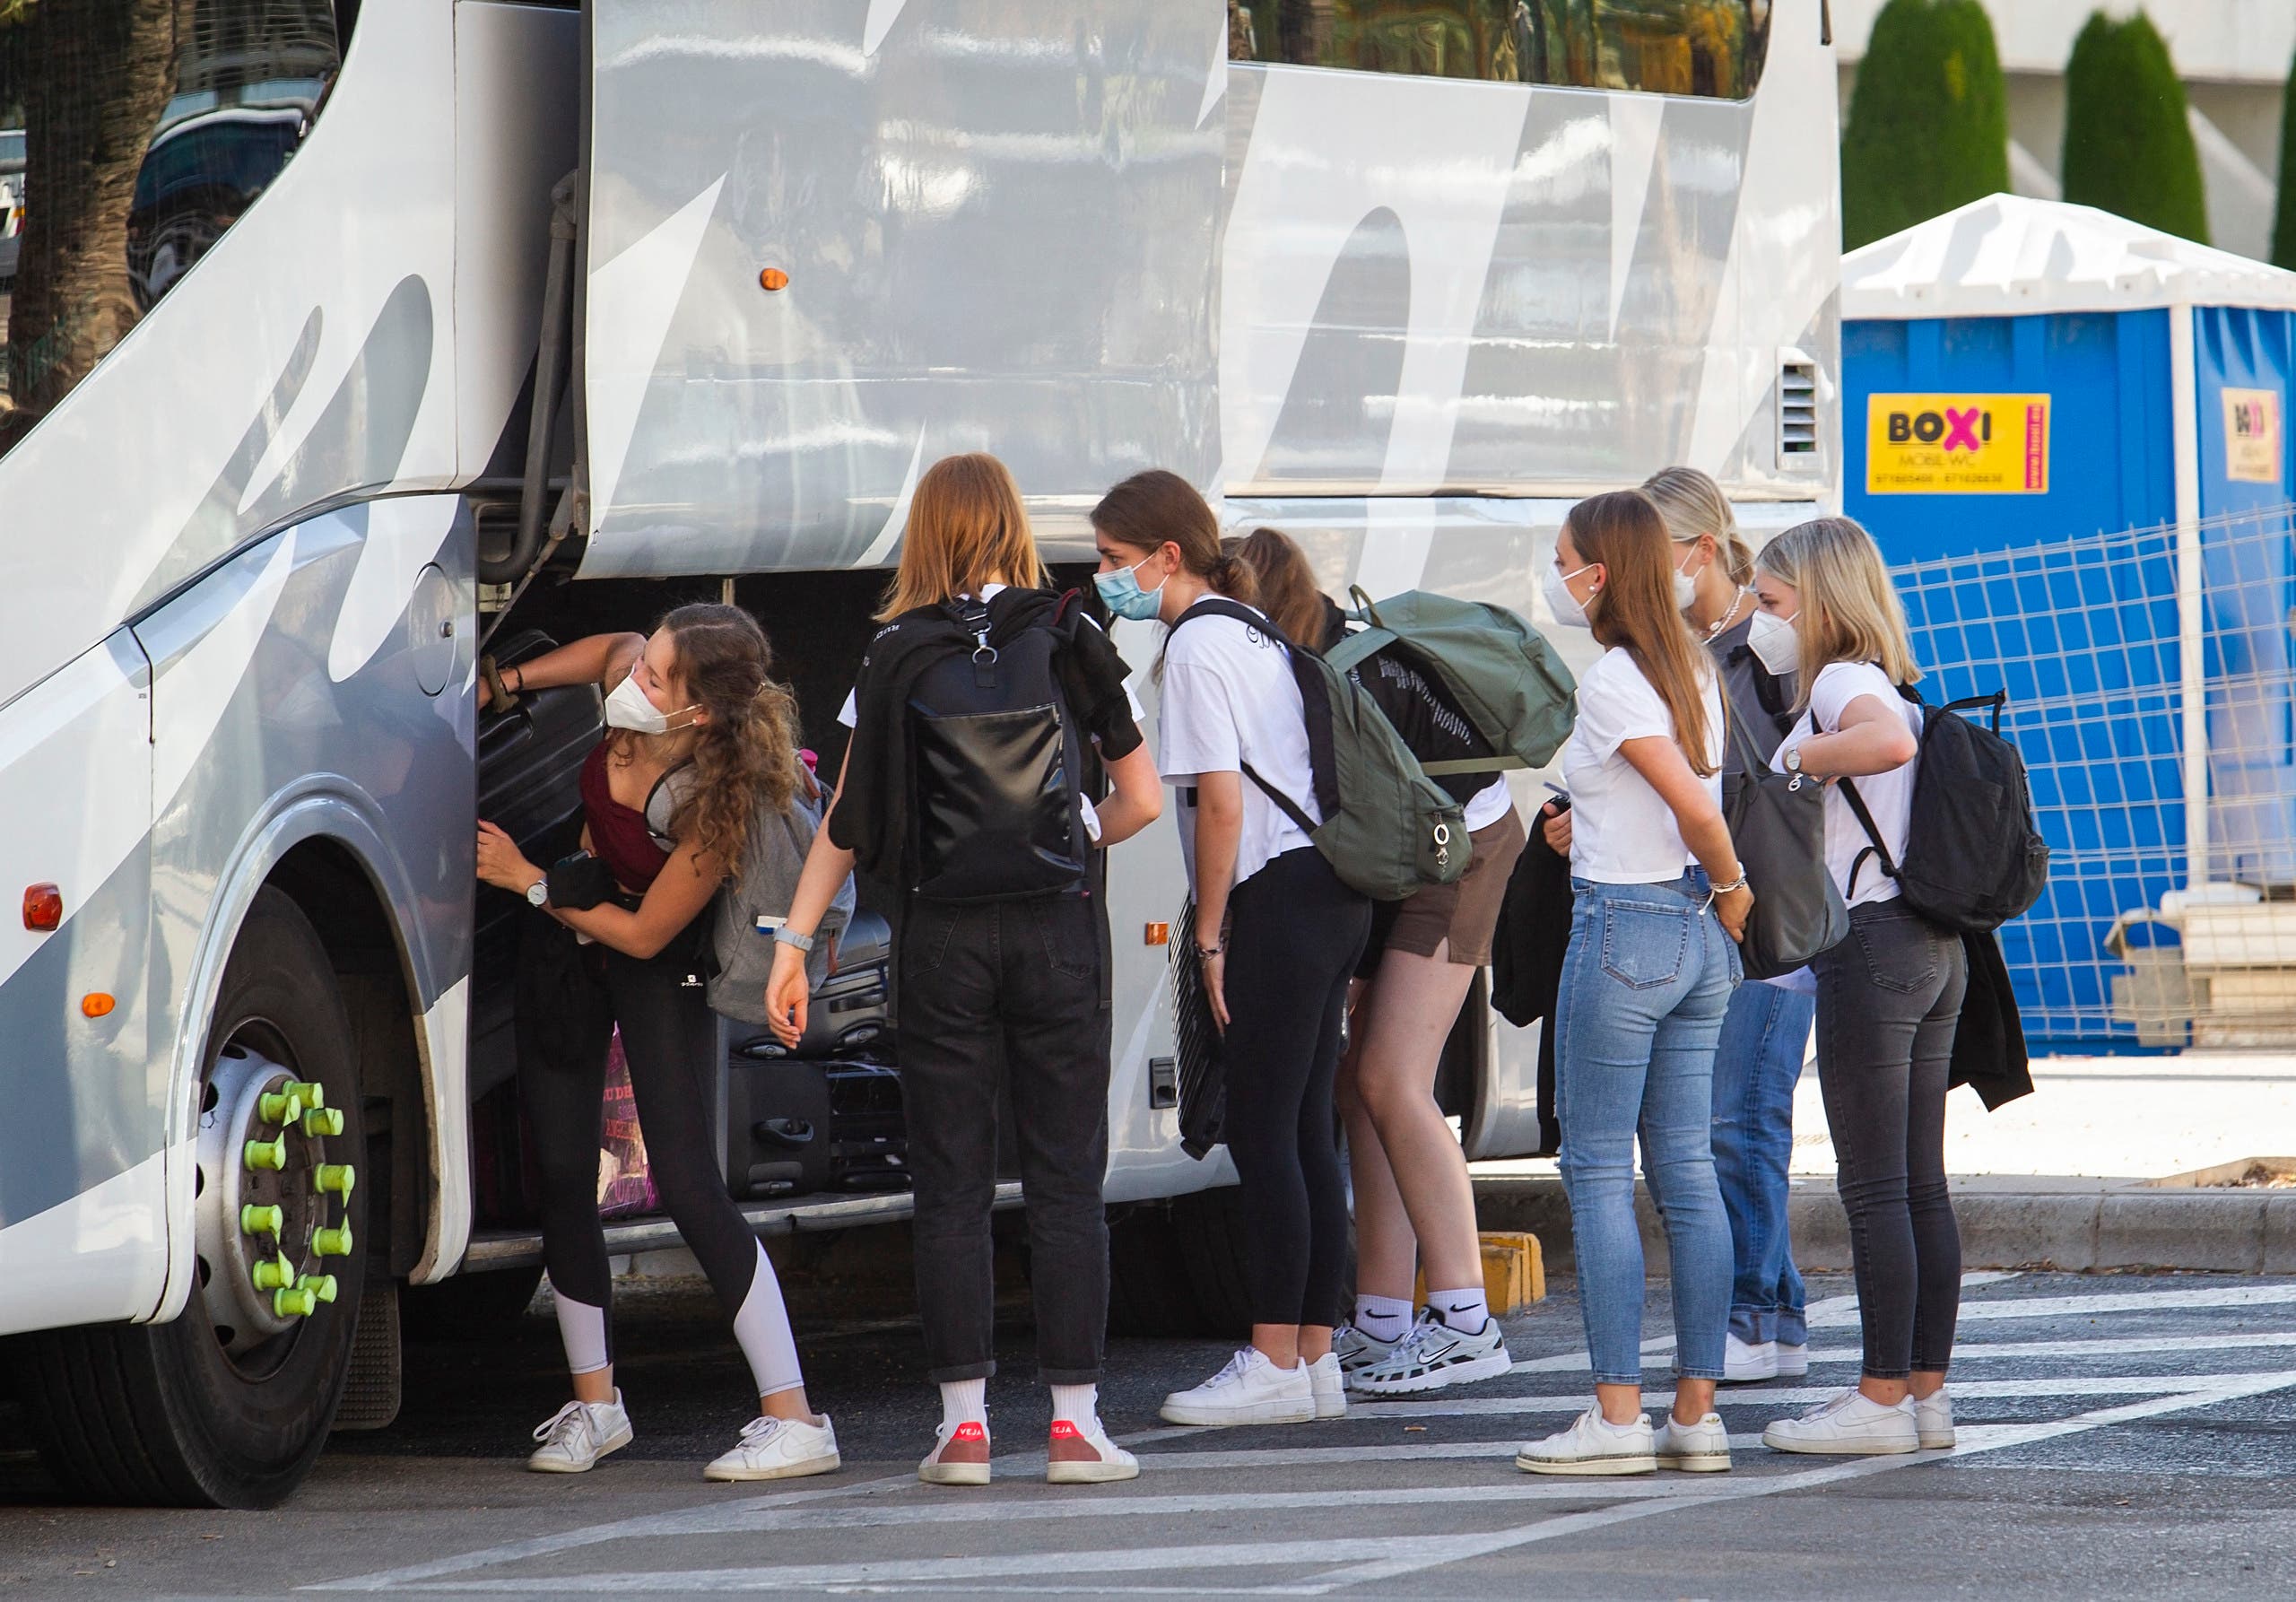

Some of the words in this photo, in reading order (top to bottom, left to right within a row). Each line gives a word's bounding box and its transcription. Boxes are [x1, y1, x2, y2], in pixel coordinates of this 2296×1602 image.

[1888, 406, 1992, 452] BOXI
[1950, 453, 1976, 466] WC
[960, 1428, 982, 1436] VEJA
